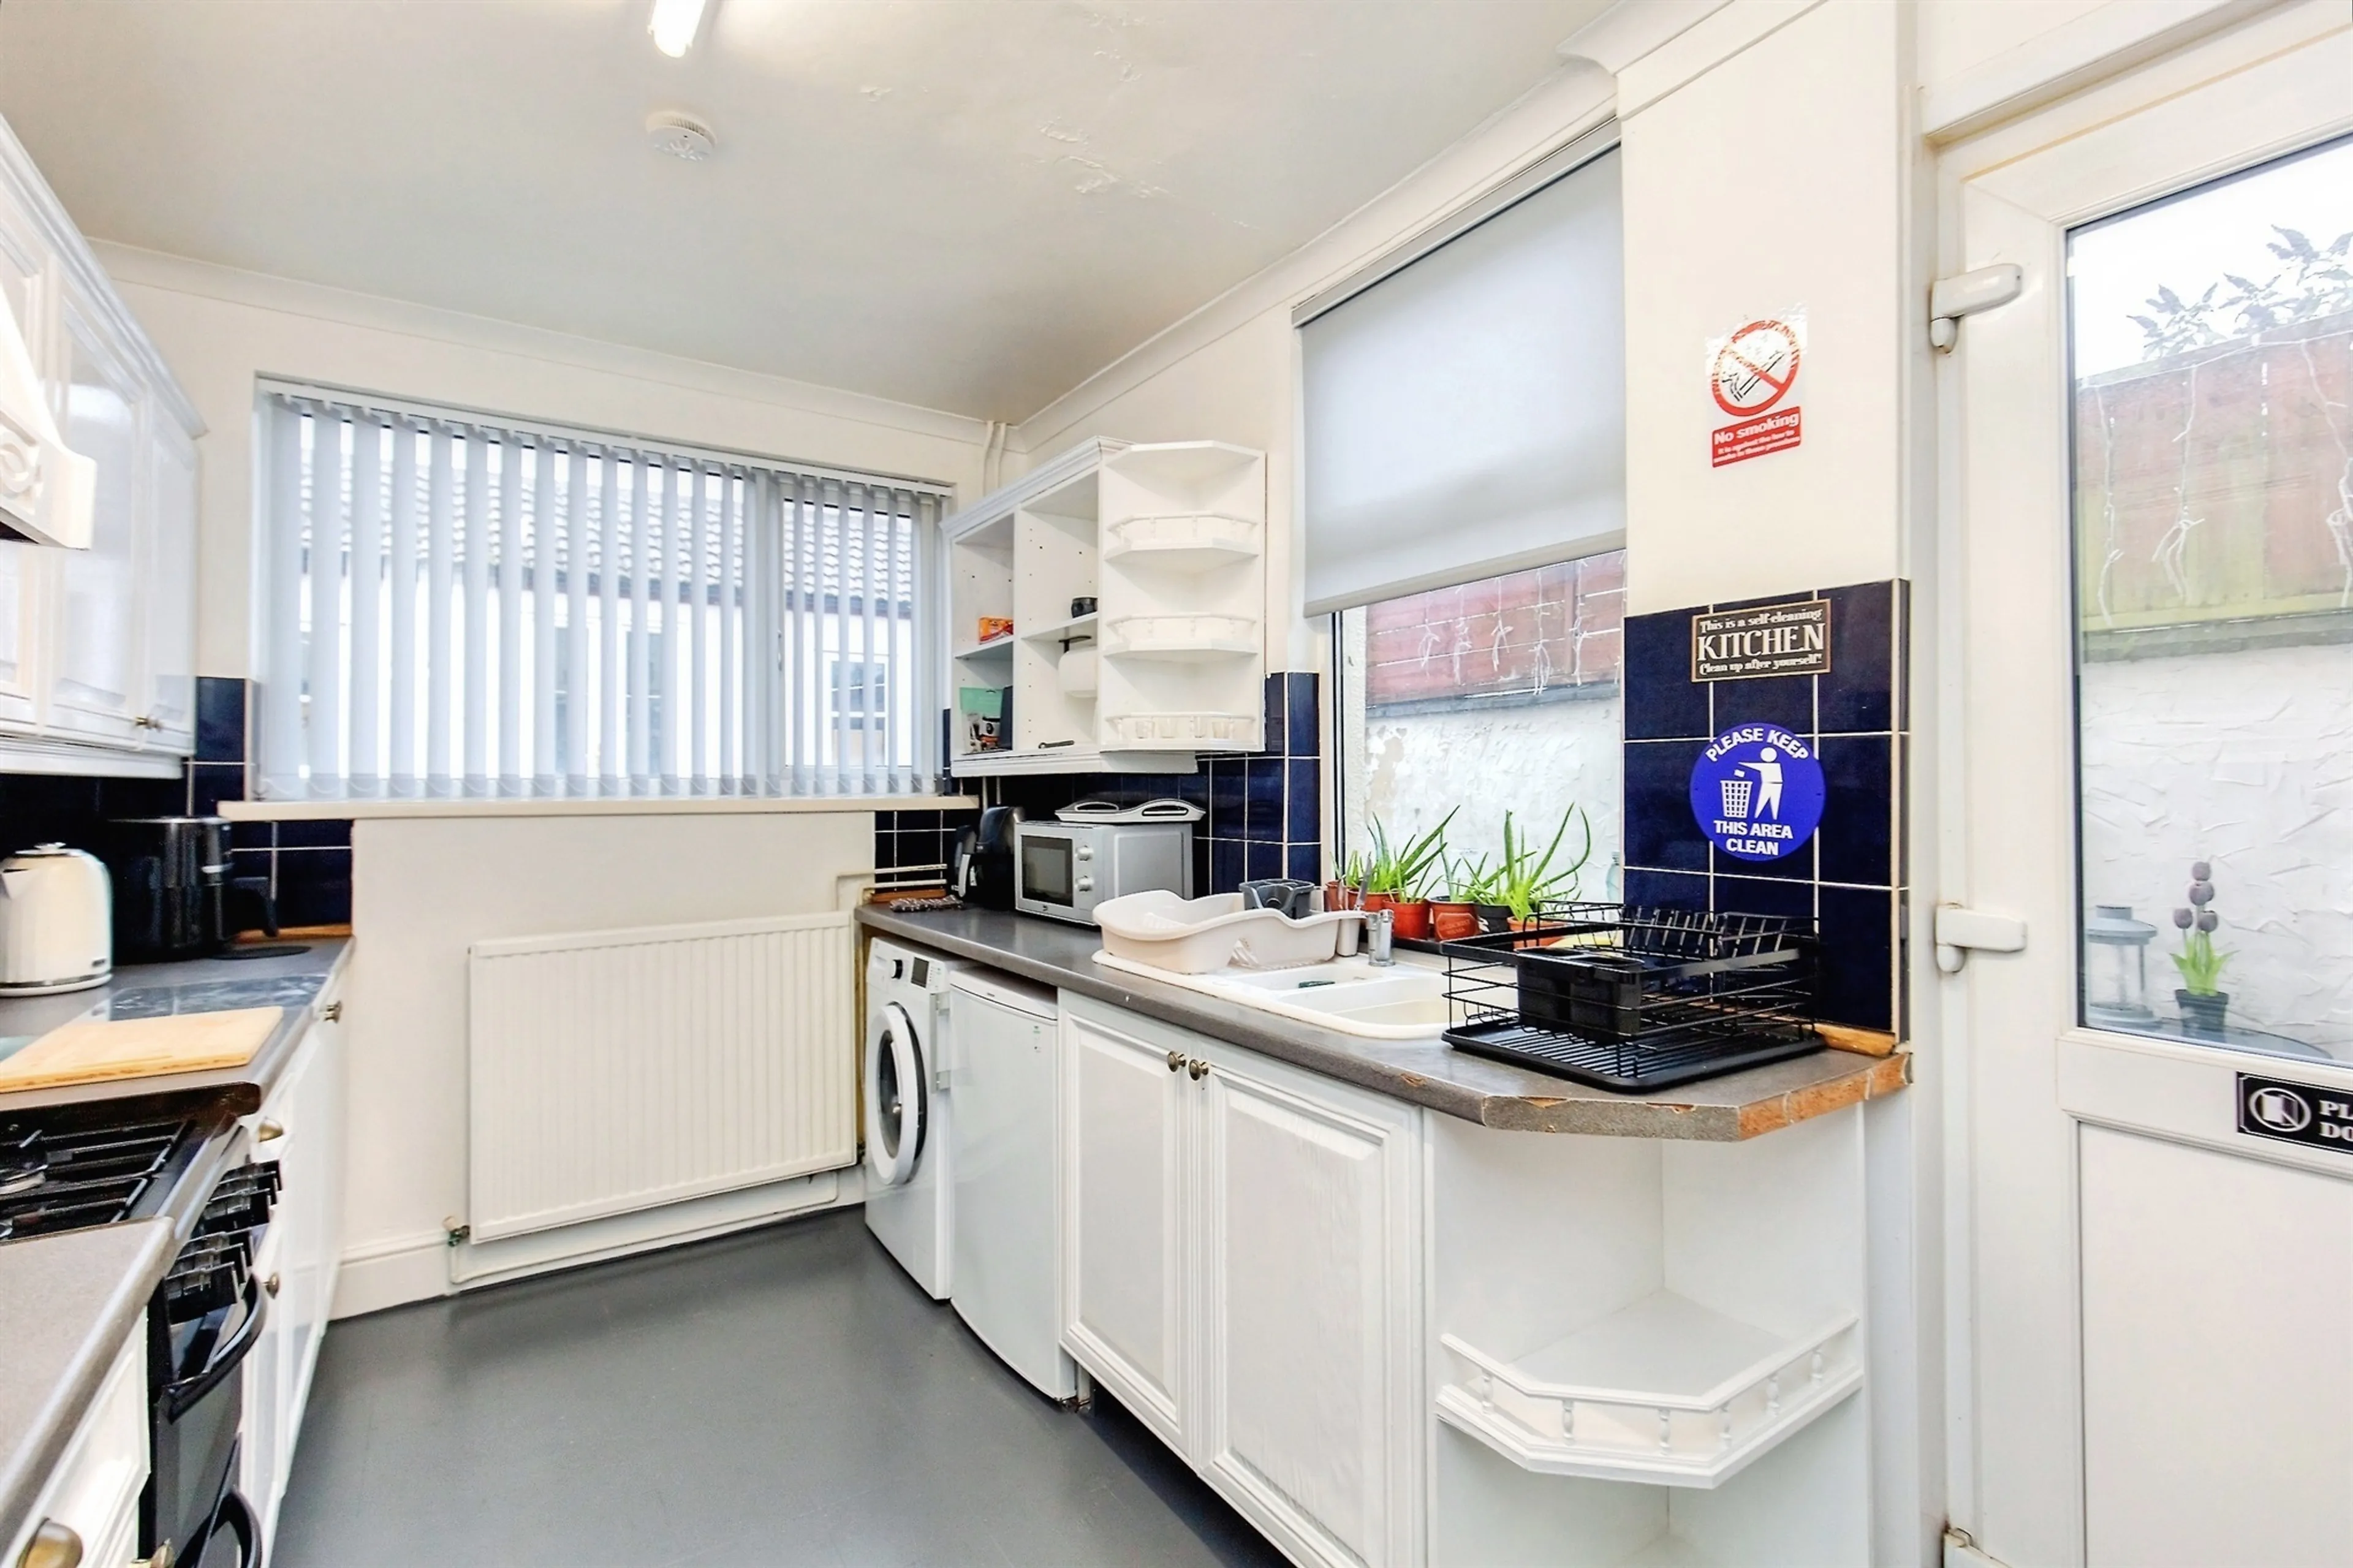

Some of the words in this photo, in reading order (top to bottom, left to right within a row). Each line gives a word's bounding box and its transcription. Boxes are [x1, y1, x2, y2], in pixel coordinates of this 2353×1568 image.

[1714, 431, 1734, 445] No
[1736, 413, 1800, 439] smoking
[1699, 620, 1723, 633] This
[1725, 618, 1736, 629] is
[1737, 619, 1746, 627] a
[1748, 608, 1823, 626] self-cleaning
[1697, 623, 1825, 661] KITCHEN
[1699, 662, 1728, 675] Clean
[1729, 663, 1743, 673] up
[1744, 659, 1771, 670] after
[1705, 728, 1764, 762] PLEASE
[1767, 729, 1809, 759] KEEP
[1713, 820, 1748, 836] THIS
[1749, 824, 1794, 839] AREA
[1726, 838, 1779, 856] CLEAN
